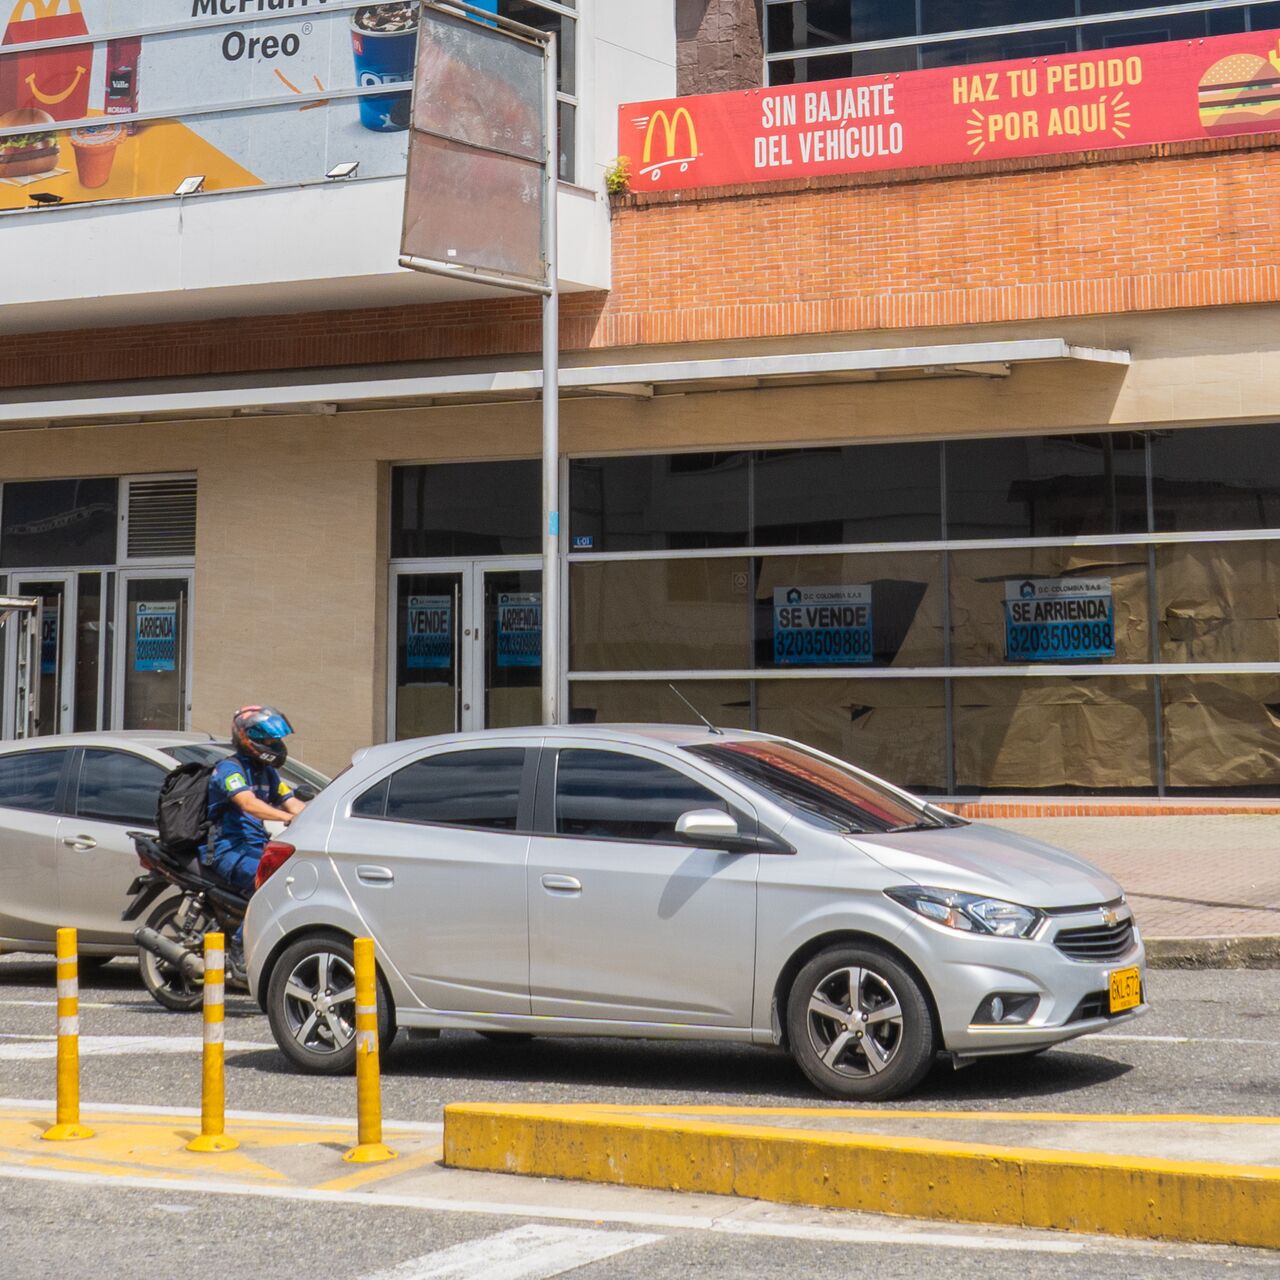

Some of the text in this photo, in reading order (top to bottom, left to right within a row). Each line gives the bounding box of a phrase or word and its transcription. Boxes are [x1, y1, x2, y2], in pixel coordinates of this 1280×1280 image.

[952, 56, 1142, 104] HAZ TU PEDIDO
[761, 83, 895, 129] SIN BAJARTE
[988, 95, 1108, 142] POR AQUÍ
[754, 120, 903, 168] DEL VEHÍCULO
[409, 610, 448, 634] VENDE
[779, 606, 867, 628] SE VENDE
[1012, 599, 1107, 622] SE ARRIENDA
[139, 616, 173, 639] ARRIENDA
[1009, 623, 1113, 653] 3203509888
[775, 630, 871, 657] 3203509888
